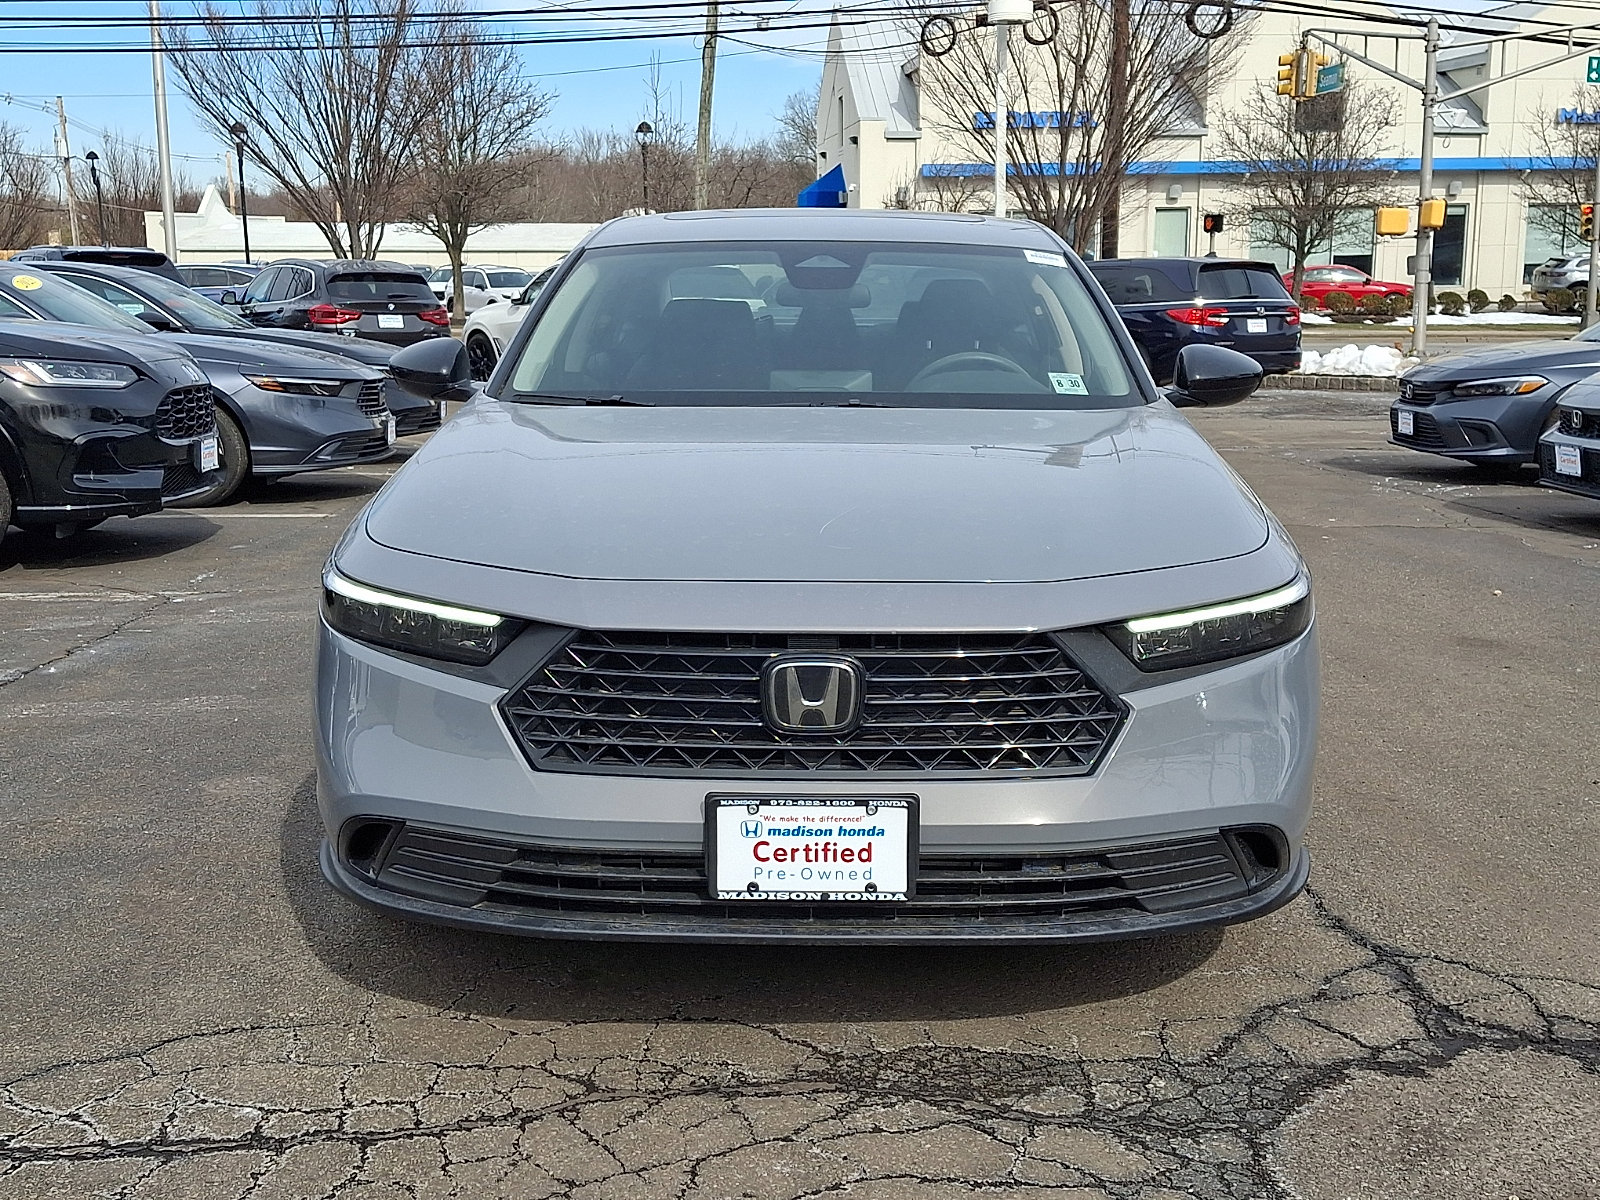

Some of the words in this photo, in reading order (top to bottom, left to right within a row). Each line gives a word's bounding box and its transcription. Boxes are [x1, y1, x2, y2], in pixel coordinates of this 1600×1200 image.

[1056, 379, 1064, 388] 8
[1068, 379, 1081, 388] 30
[779, 815, 799, 823] make
[802, 815, 816, 823] the
[767, 825, 833, 837] madison
[837, 825, 885, 837] honda
[753, 840, 873, 863] Certified
[754, 866, 873, 881] Pre-Owned
[717, 891, 824, 901] MADISON
[827, 892, 909, 901] HONDA
